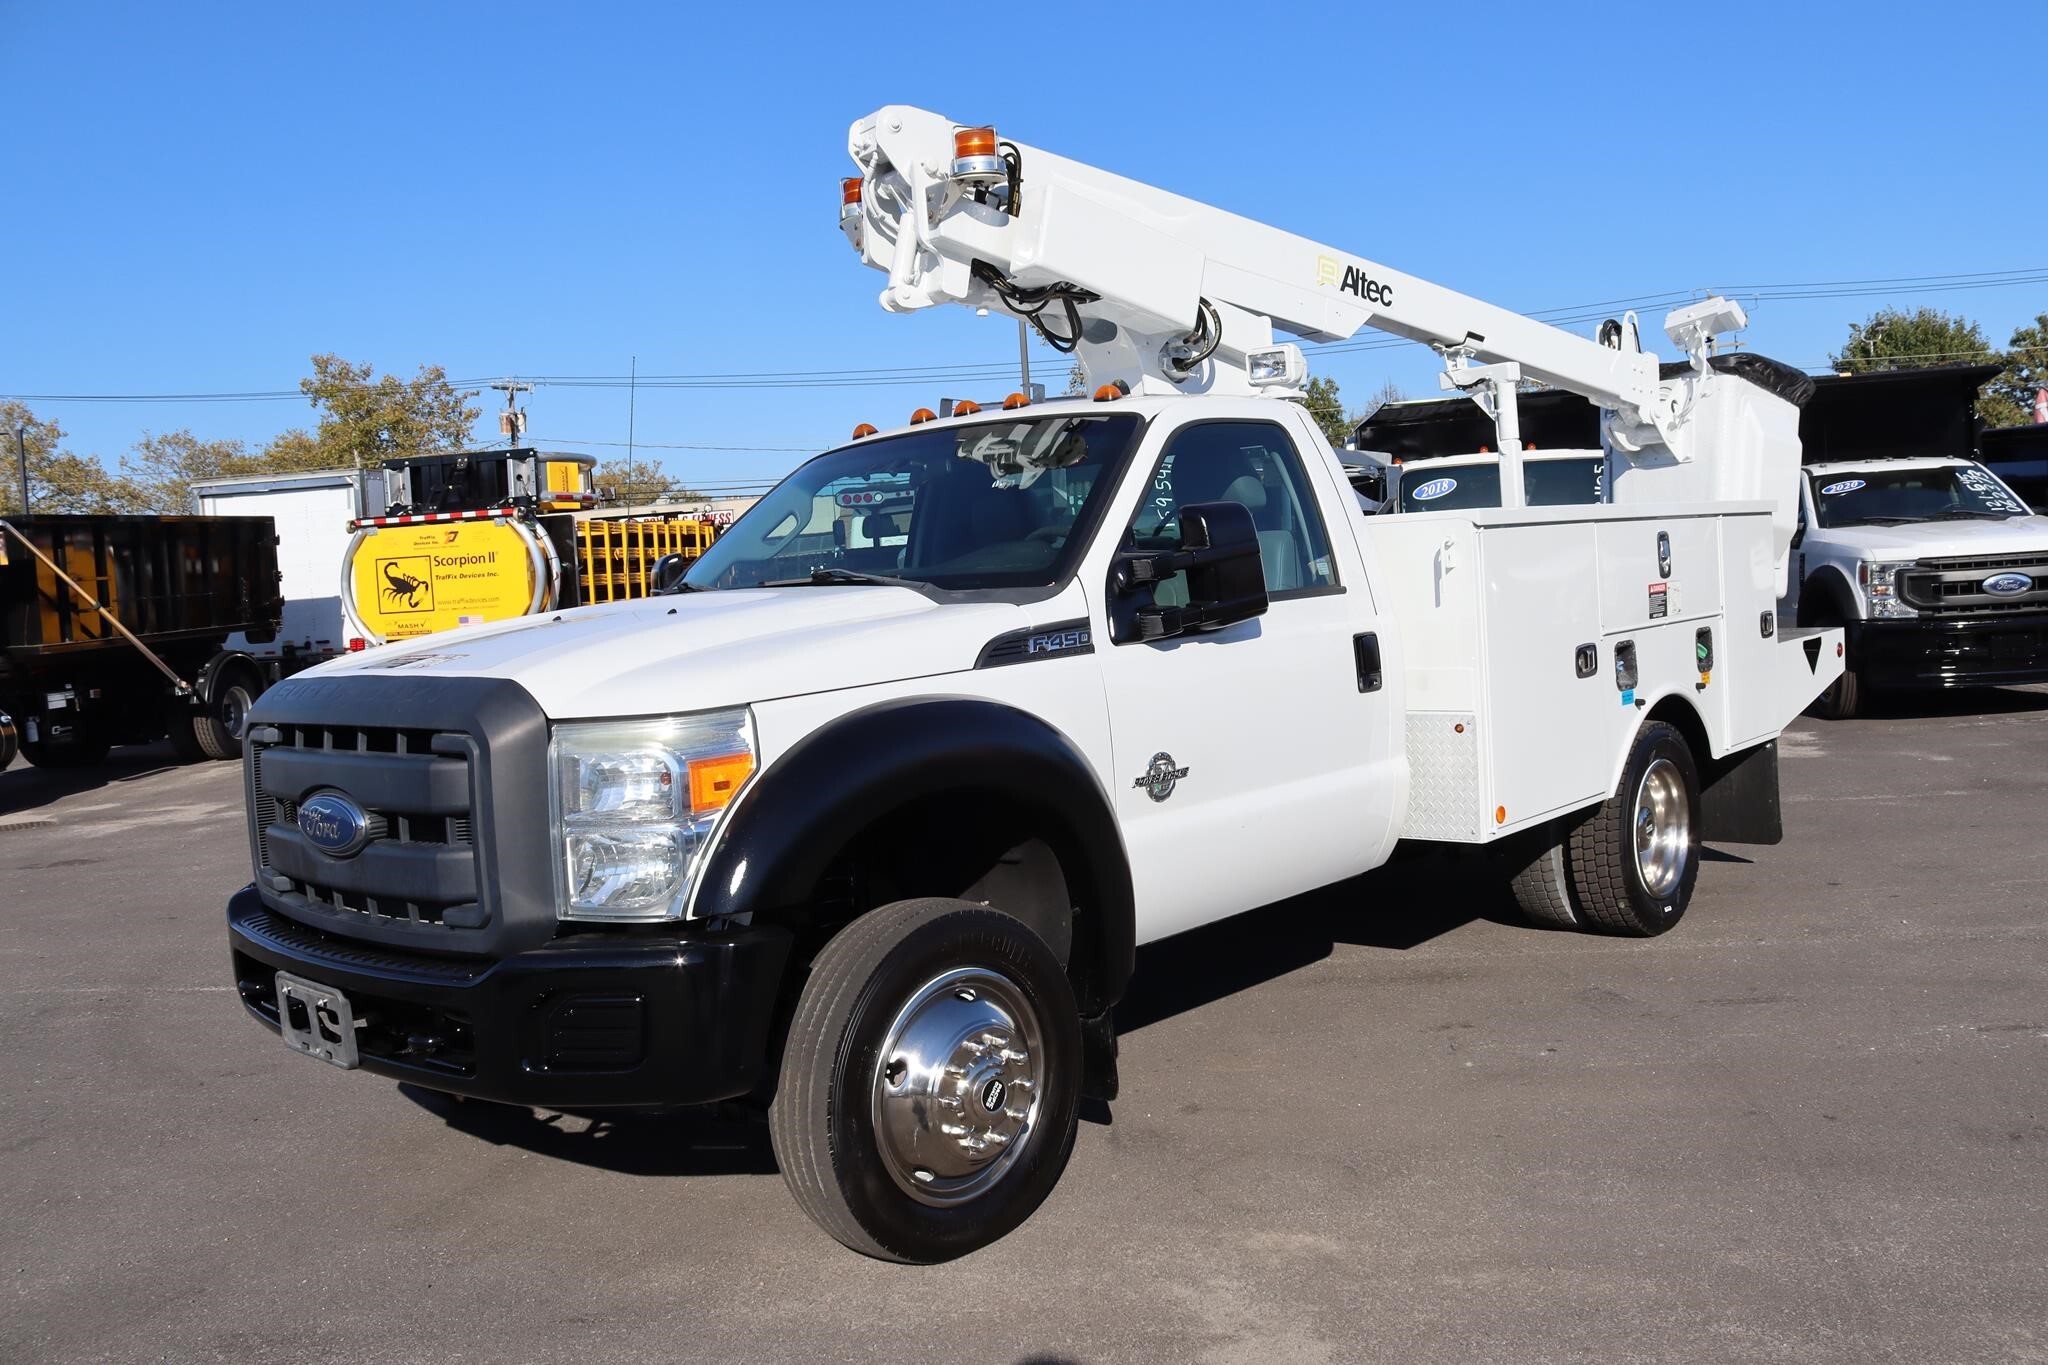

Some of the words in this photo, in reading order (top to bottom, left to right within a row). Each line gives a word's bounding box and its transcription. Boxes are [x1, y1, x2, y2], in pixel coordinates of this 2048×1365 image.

[1340, 265, 1393, 307] Altec
[1421, 480, 1449, 498] 2018
[1831, 481, 1858, 492] 2020
[433, 553, 486, 568] Scorpion
[1996, 579, 2020, 590] Ford
[306, 805, 341, 840] Ford
